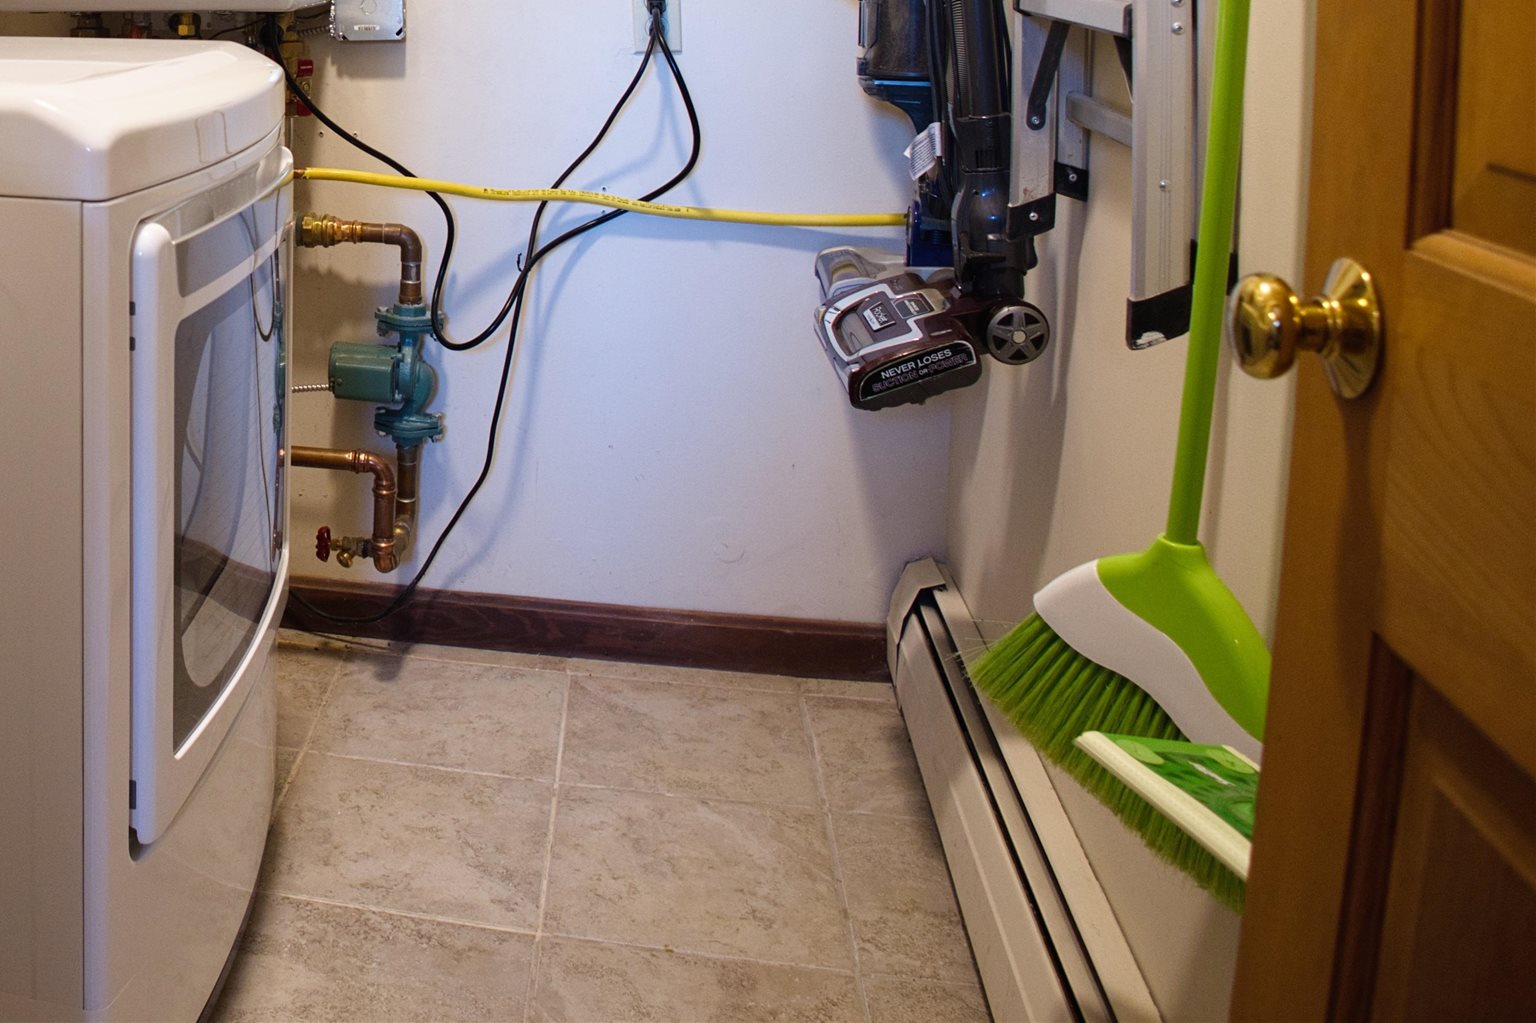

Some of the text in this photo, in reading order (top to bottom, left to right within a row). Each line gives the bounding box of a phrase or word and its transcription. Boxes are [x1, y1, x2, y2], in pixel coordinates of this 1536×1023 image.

[871, 353, 968, 393] SUCTION OR POWER
[880, 349, 952, 380] NEVER LOSES
